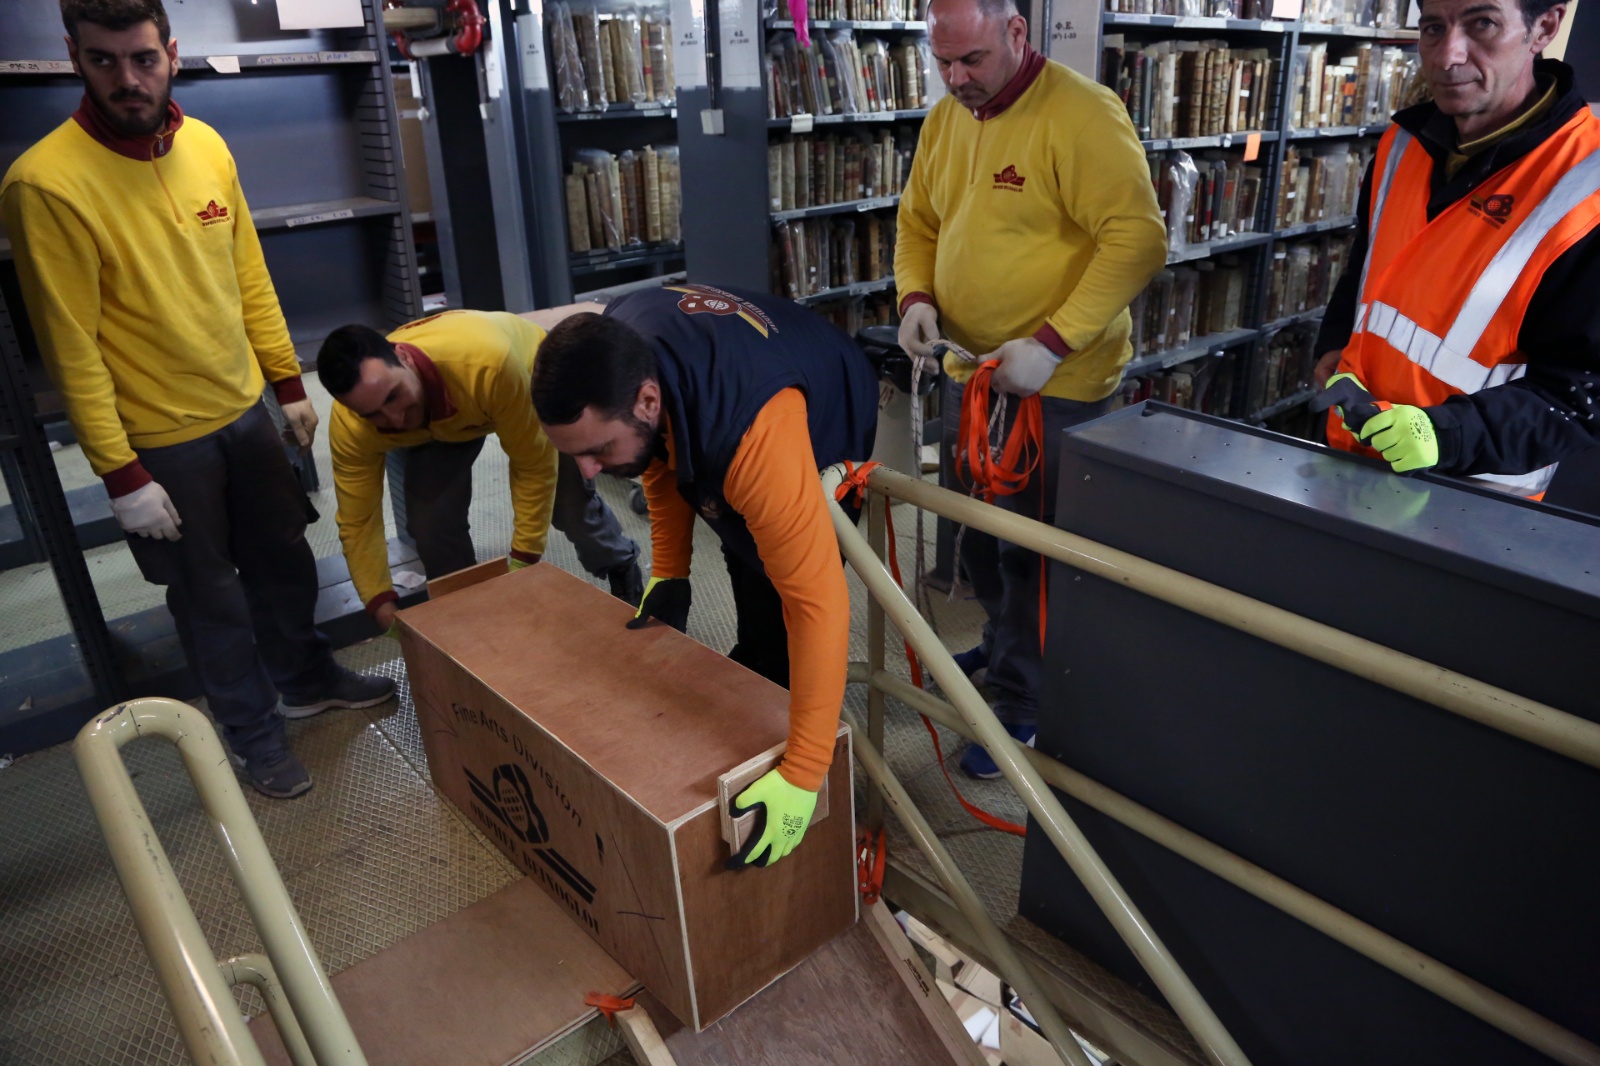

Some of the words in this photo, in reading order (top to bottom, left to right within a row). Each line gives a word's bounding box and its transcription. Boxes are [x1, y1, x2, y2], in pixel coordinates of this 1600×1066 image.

[451, 702, 478, 725] Fine
[479, 709, 509, 743] Arts
[512, 733, 583, 828] Division
